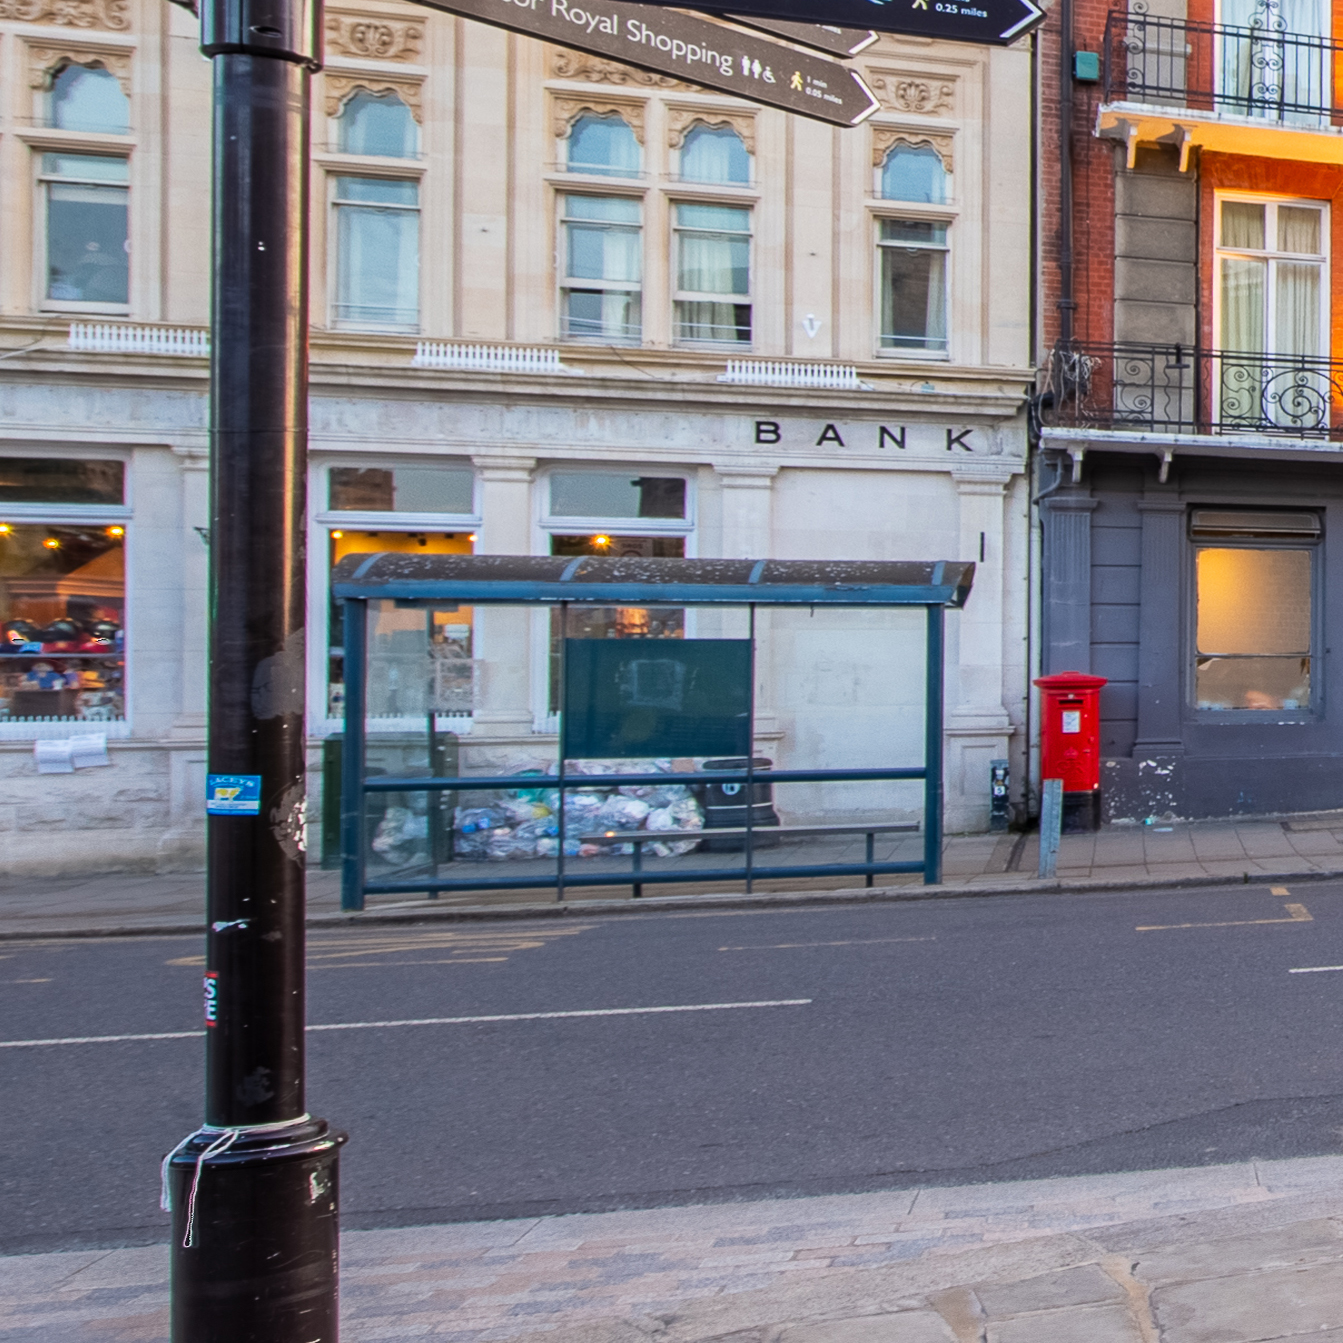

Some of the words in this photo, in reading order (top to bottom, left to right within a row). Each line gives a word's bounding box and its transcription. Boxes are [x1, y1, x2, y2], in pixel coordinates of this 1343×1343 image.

[935, 2, 958, 14] 0.25
[960, 7, 988, 18] miles
[626, 19, 734, 77] Shopping
[755, 421, 974, 452] BANK
